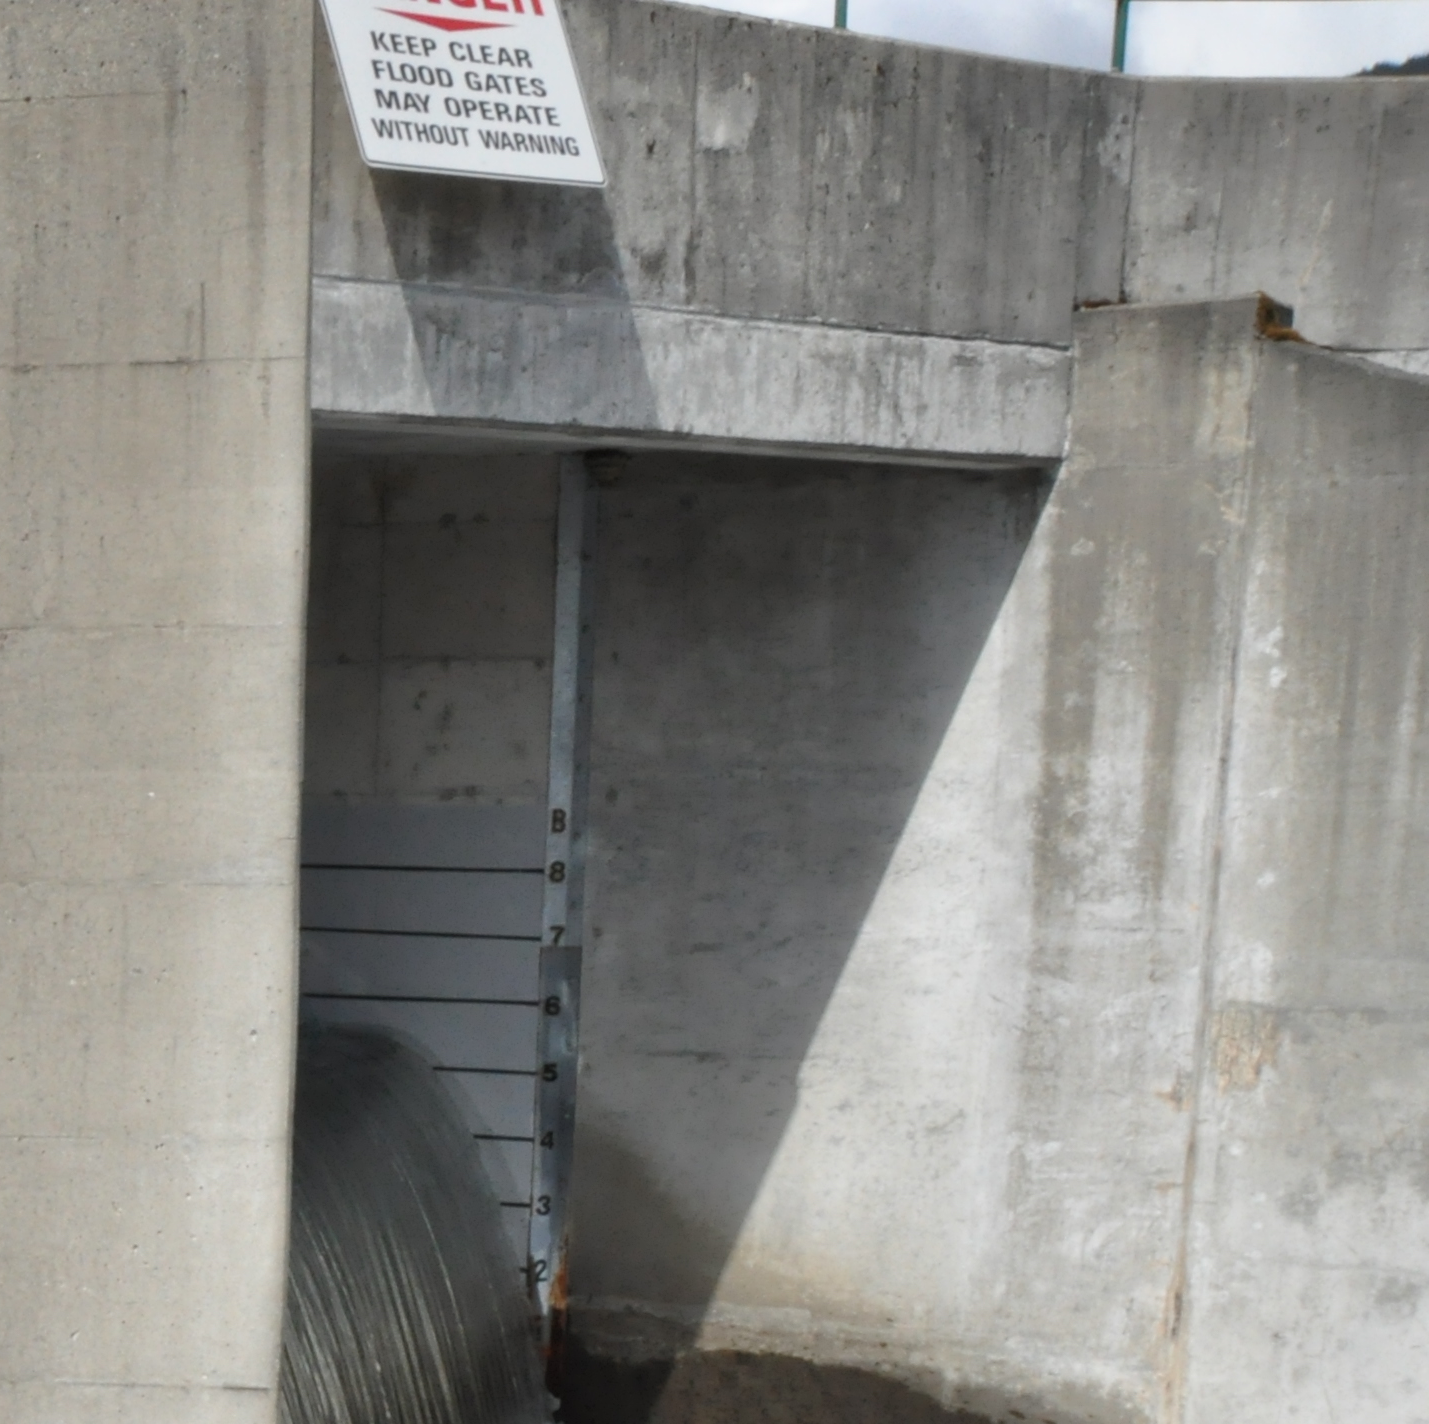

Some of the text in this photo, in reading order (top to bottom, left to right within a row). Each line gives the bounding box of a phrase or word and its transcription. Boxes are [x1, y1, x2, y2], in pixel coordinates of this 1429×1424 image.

[370, 30, 533, 69] KEEP CLEAR
[371, 59, 547, 98] FLOOD GATES
[374, 88, 561, 127] MAY OPERATE
[371, 117, 580, 157] WITHOUT WARNING
[552, 808, 566, 834] B
[549, 861, 566, 883] 8
[549, 926, 565, 946] 7
[545, 996, 561, 1016] 6
[542, 1063, 558, 1082] 5
[540, 1131, 554, 1149] 4
[536, 1195, 551, 1215] 3
[535, 1259, 548, 1282] 2
